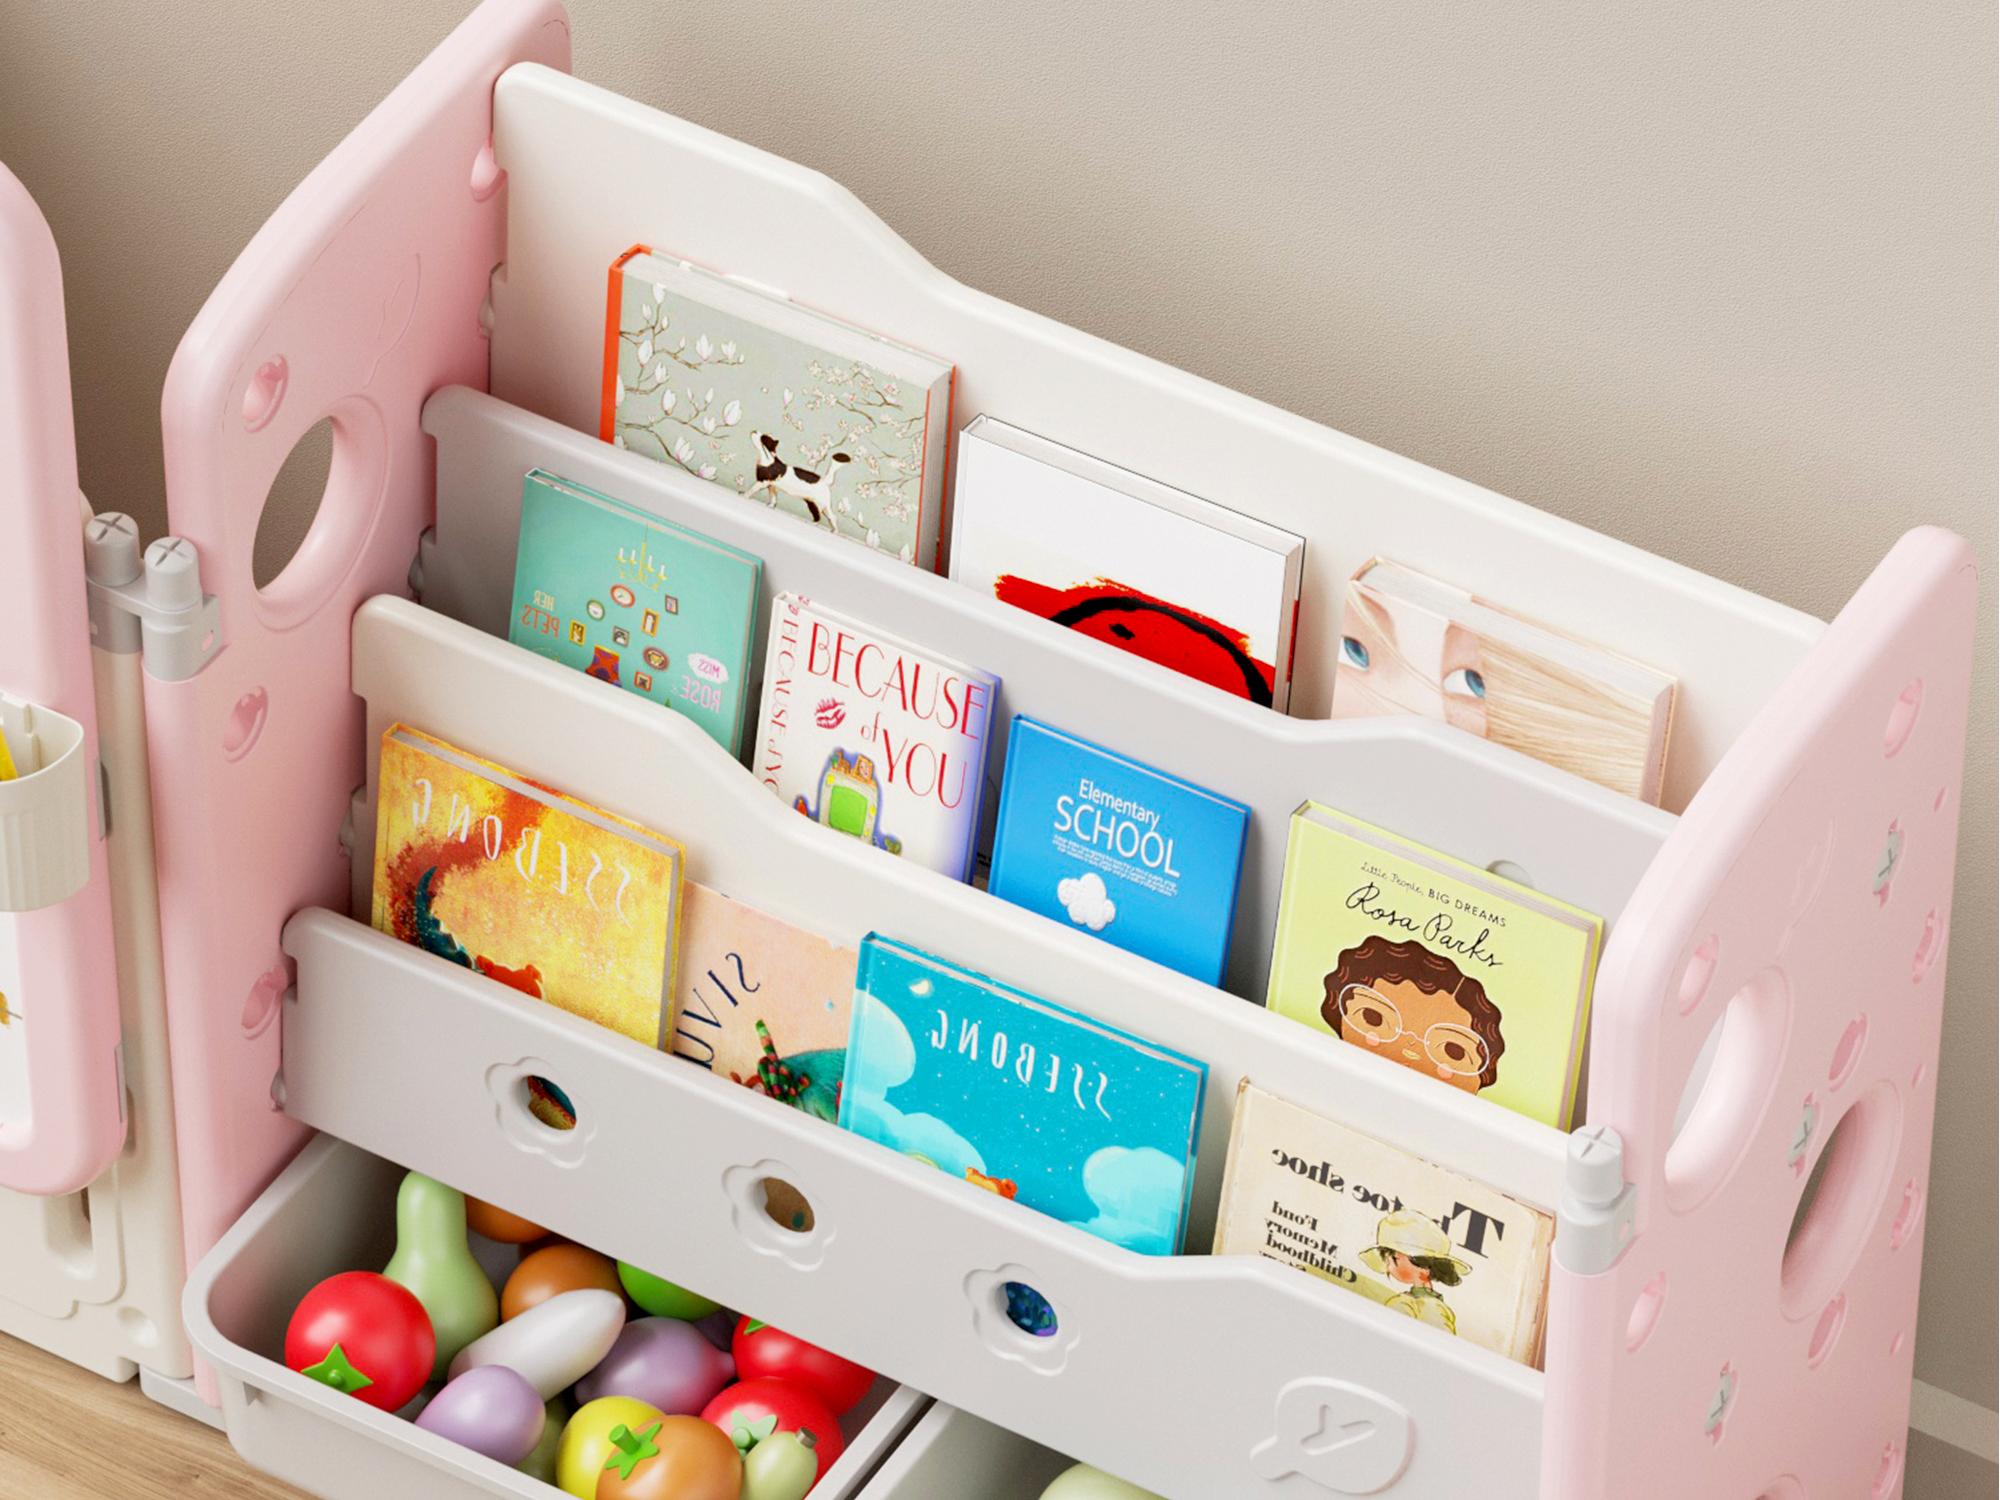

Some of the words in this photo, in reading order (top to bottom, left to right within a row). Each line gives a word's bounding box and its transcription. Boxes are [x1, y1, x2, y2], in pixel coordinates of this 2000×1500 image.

[807, 621, 985, 740] BECAUSE
[860, 711, 881, 742] of
[882, 729, 967, 809] YOU
[1079, 778, 1160, 831] Elementary
[1053, 795, 1181, 878] SCHOOL
[1345, 882, 1421, 931] Rosa
[1423, 913, 1504, 967] Parks
[1428, 888, 1450, 904] BIG
[1454, 899, 1507, 927] DREAMS
